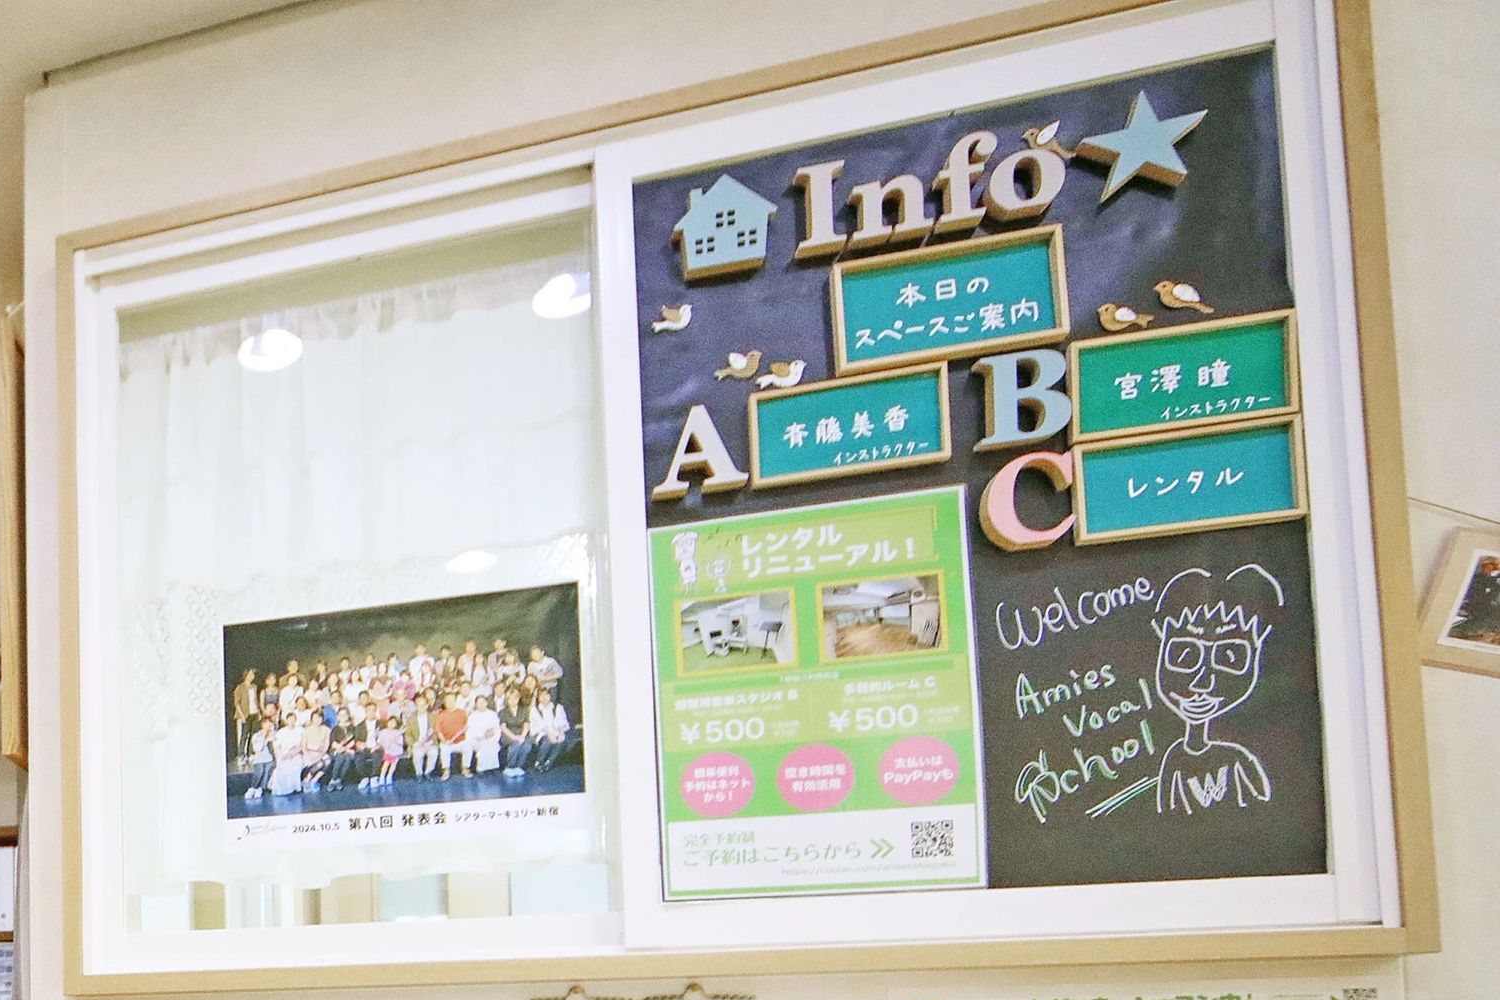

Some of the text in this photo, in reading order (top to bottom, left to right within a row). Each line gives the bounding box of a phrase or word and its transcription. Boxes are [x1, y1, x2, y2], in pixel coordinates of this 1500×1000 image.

[793, 131, 1067, 257] Info
[896, 277, 990, 308] 本日の
[856, 298, 1040, 349] スペースご案内
[971, 348, 1073, 450] B
[1160, 395, 1271, 420] インストラクター
[651, 404, 750, 500] A
[833, 442, 930, 466] インストラクター
[980, 450, 1077, 551] C
[1126, 467, 1245, 499] レンタル
[741, 523, 844, 557] レンタル
[996, 577, 1154, 650] Welcome
[1015, 664, 1116, 719] Amies
[1062, 678, 1153, 738] Vocal
[1015, 719, 1155, 824] School
[292, 822, 341, 835] 2024.10.5
[348, 815, 394, 831] 第八回
[401, 811, 448, 828] 発表会
[683, 841, 862, 867] ご予約はこちらから
